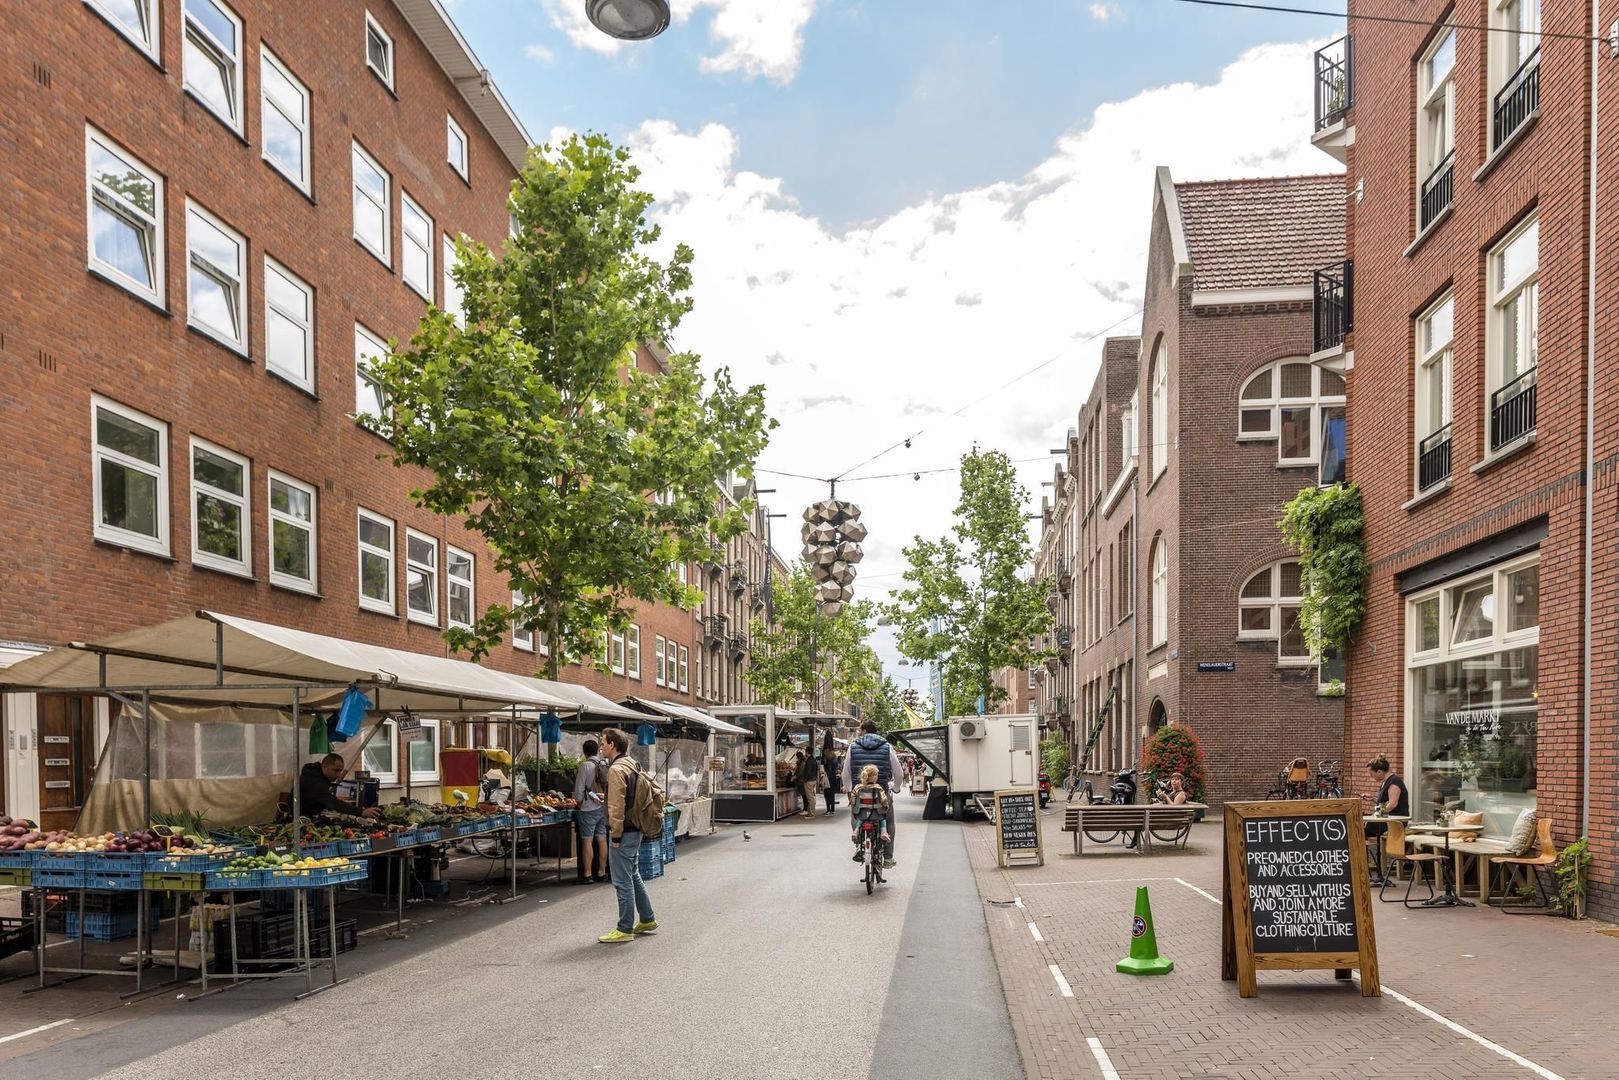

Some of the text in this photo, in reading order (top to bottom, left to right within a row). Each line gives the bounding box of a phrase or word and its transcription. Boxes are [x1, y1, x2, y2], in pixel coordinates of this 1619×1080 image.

[1445, 709, 1500, 725] VAN DE MARKT
[1246, 819, 1346, 842] EFFECT(S)
[1302, 849, 1350, 864] CLOTHES
[1257, 863, 1343, 878] AND ACCESSORIES
[1249, 883, 1351, 899] BUY AND SELL WITH US
[1253, 896, 1347, 912] AND JOIN A MORE
[1272, 910, 1339, 924] SUSTAINABLE
[1255, 923, 1354, 937] CLOTHING CULTURE
